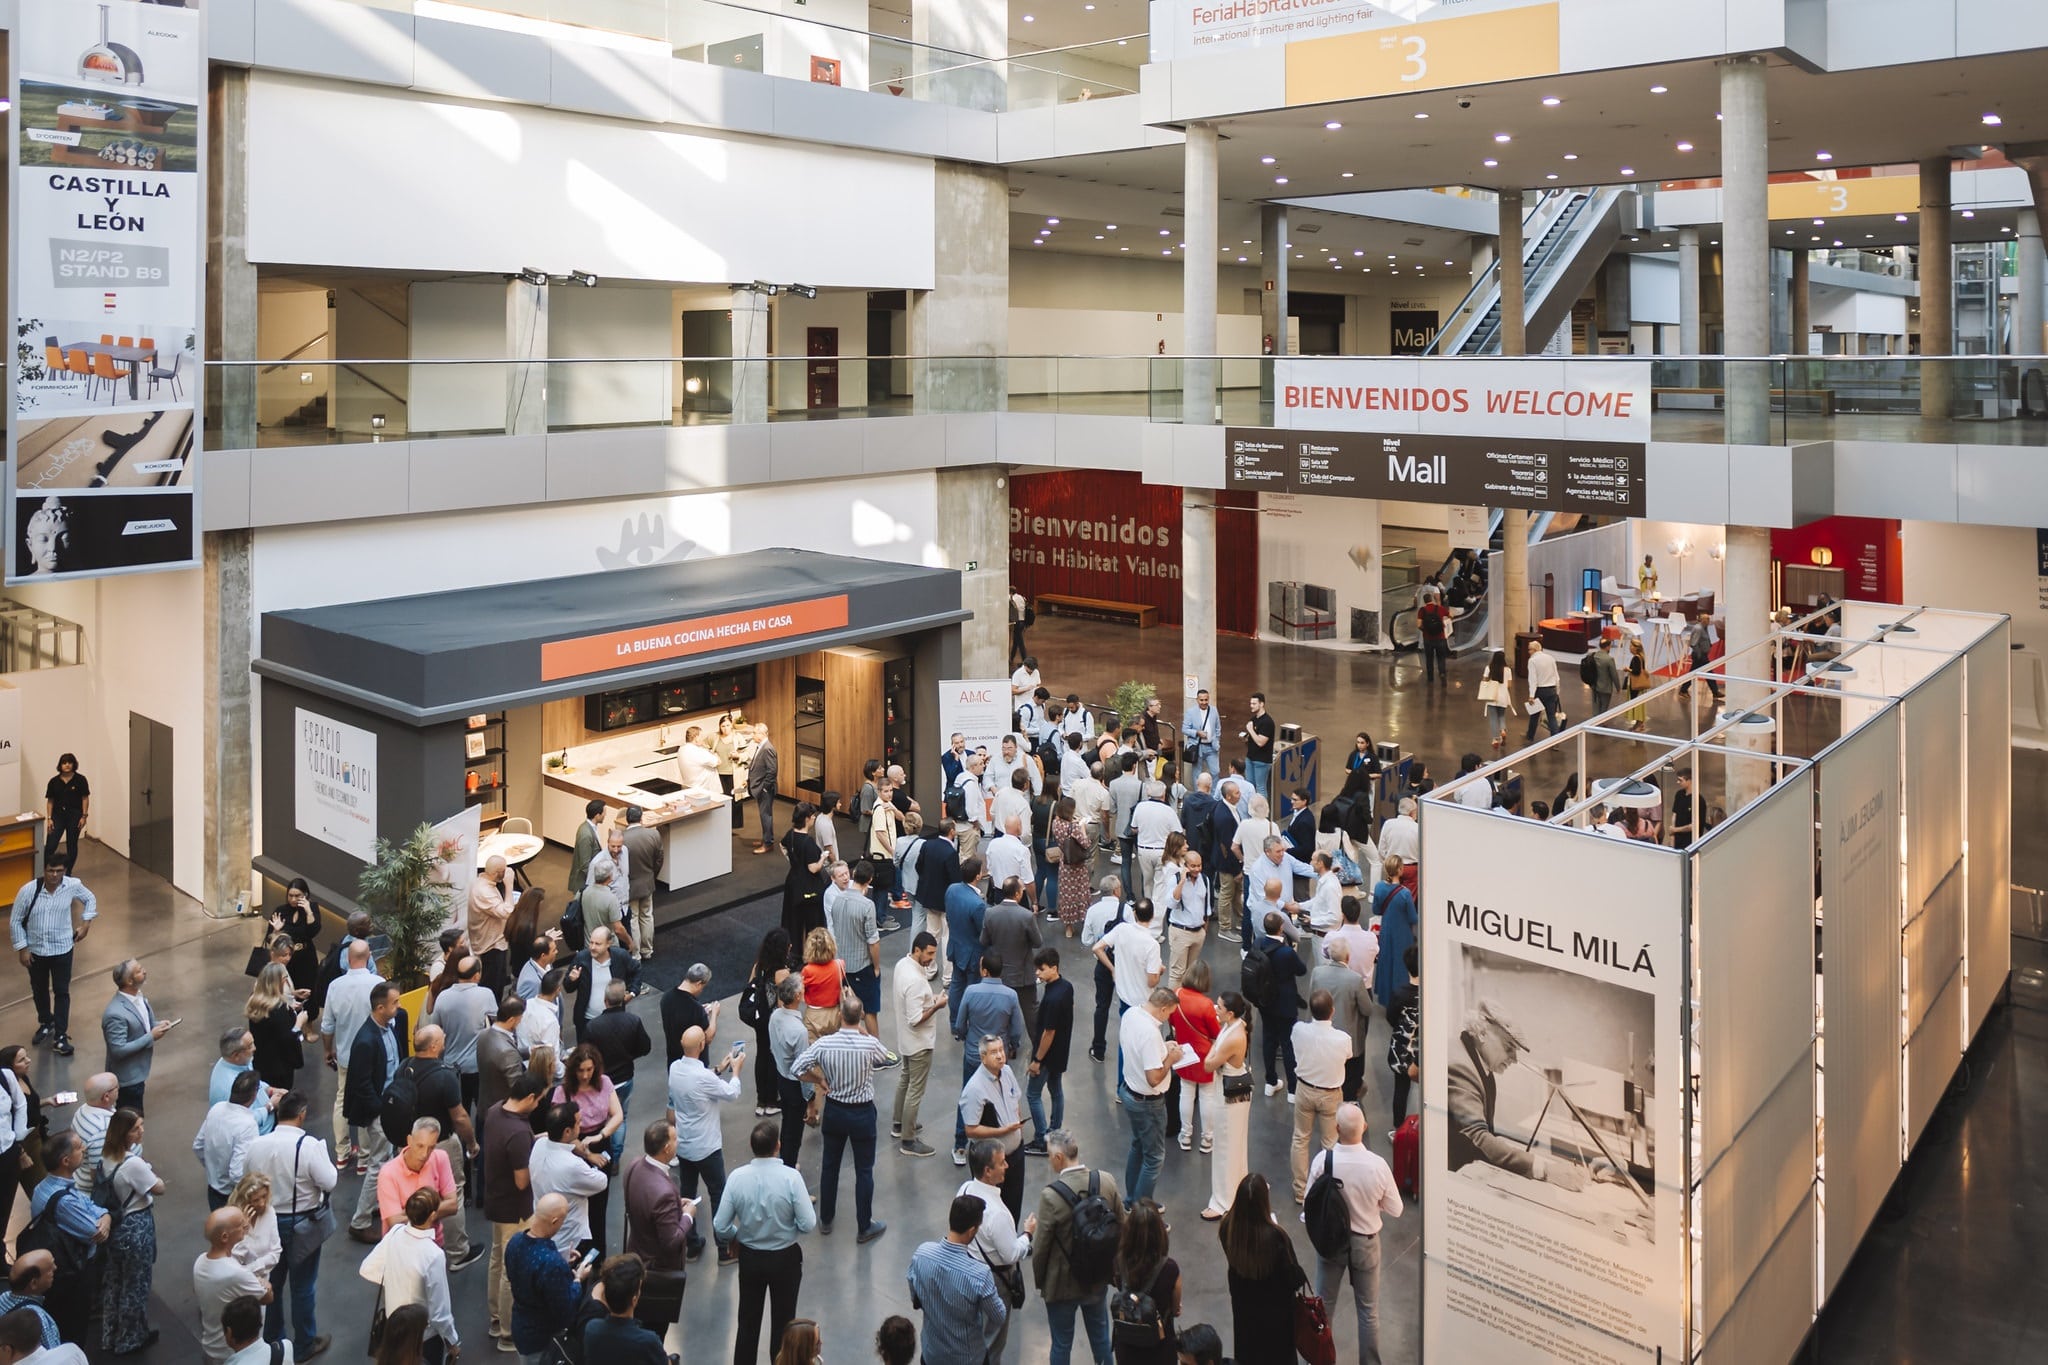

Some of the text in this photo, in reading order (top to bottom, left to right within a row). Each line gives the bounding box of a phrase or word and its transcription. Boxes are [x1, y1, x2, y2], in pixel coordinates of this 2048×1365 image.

[1296, 17, 1315, 29] and
[1316, 12, 1354, 28] lighting
[1356, 9, 1374, 20] fair
[1401, 35, 1427, 82] 3
[49, 174, 171, 198] CASTILLA
[1830, 186, 1848, 212] 3
[104, 197, 119, 212] Y
[78, 212, 144, 232] LEÓN
[60, 248, 124, 264] N2/P2
[60, 264, 162, 280] STAND B9
[1285, 386, 1634, 418] BIENVENIDOS WELCOME
[1388, 454, 1447, 484] Mall
[1009, 507, 1170, 547] Bienvenidos
[1010, 544, 1046, 566] eria
[1125, 554, 1182, 580] Valen
[616, 615, 793, 656] LA BUENA COCINA HECHA EN CASA
[960, 690, 992, 704] AMC
[304, 720, 342, 754] ESPACIO
[308, 748, 342, 782] COCINA
[1447, 899, 1656, 978] MIGUEL MILÁ
